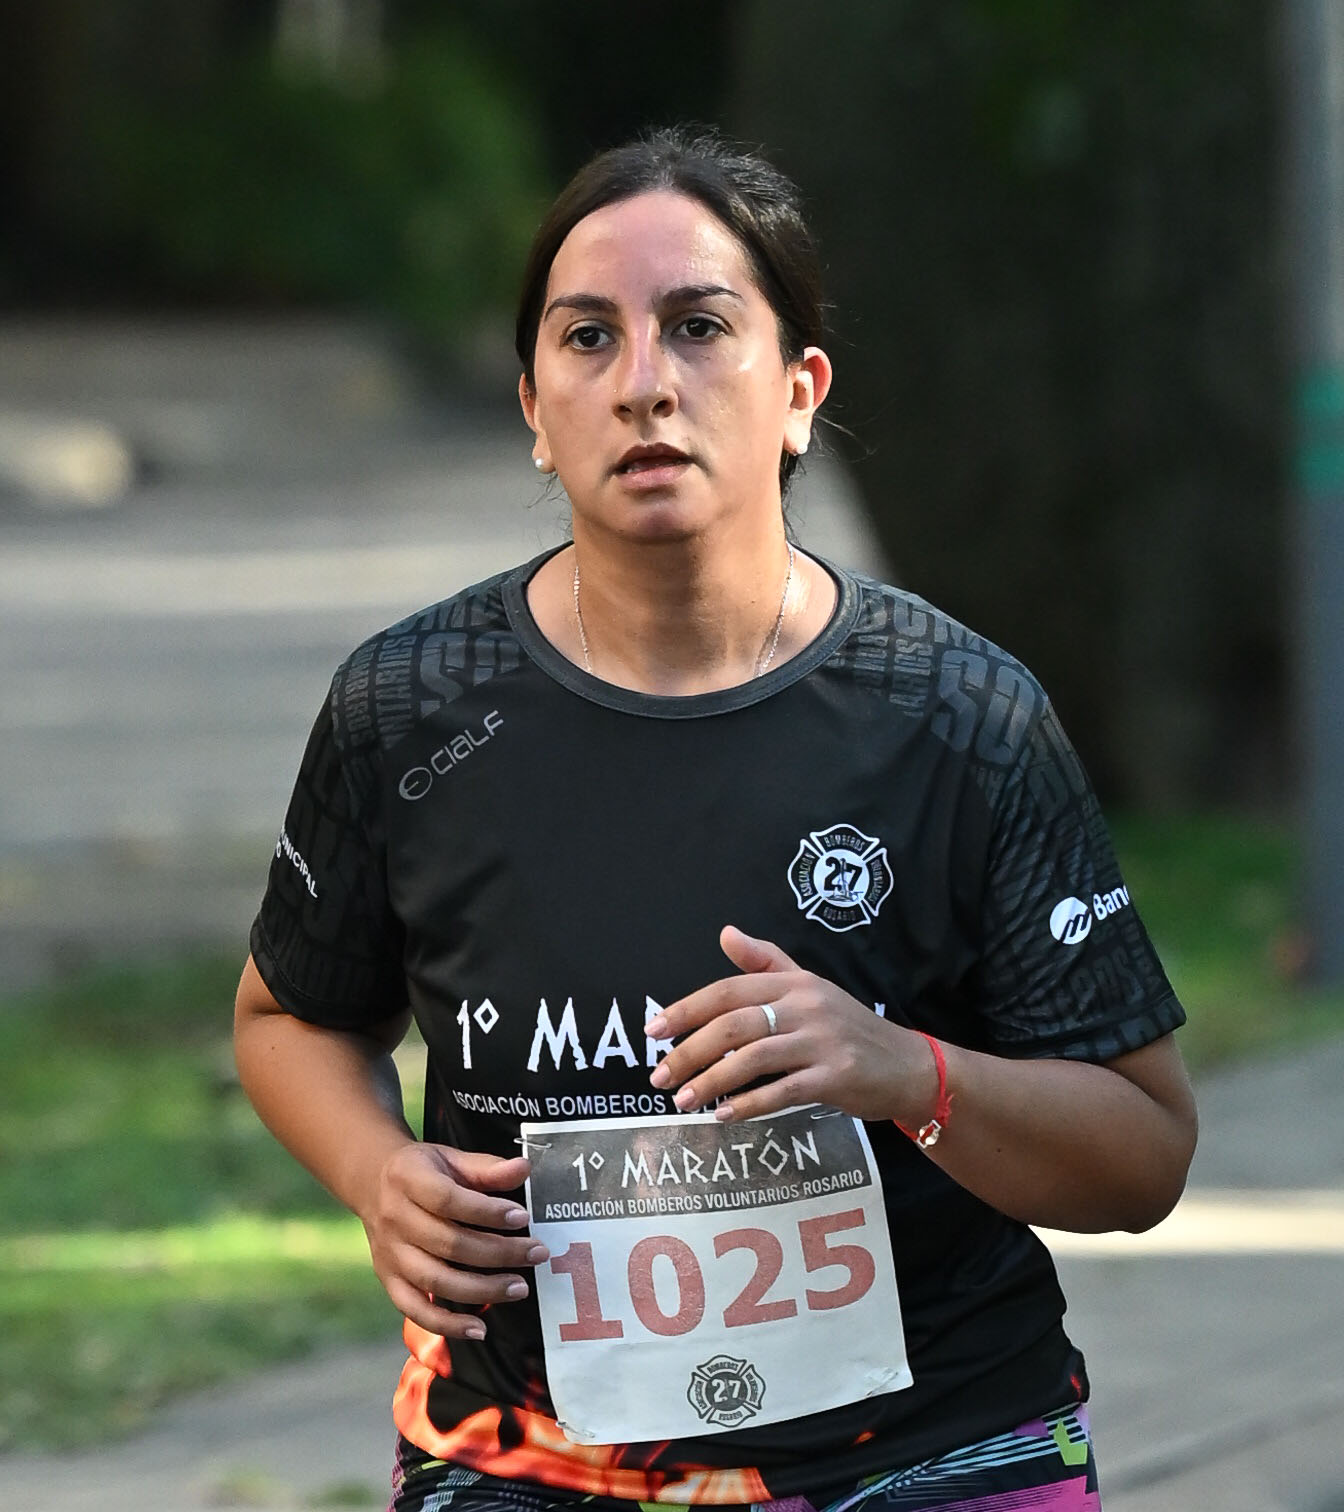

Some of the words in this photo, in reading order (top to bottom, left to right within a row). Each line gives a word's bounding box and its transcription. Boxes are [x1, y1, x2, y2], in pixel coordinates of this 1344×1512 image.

[1093, 884, 1130, 921] Ban
[527, 994, 675, 1073] MAR
[545, 1093, 667, 1116] BOMBEROS
[620, 1128, 822, 1189] MARATÓN
[545, 1196, 625, 1220] ASOCIACIÓN
[627, 1194, 703, 1215] BOMBEROS
[704, 1184, 800, 1210] VOLUNTARIOS
[801, 1168, 865, 1197] ROSARIO
[549, 1207, 877, 1343] 1025
[711, 1378, 742, 1404] 27
